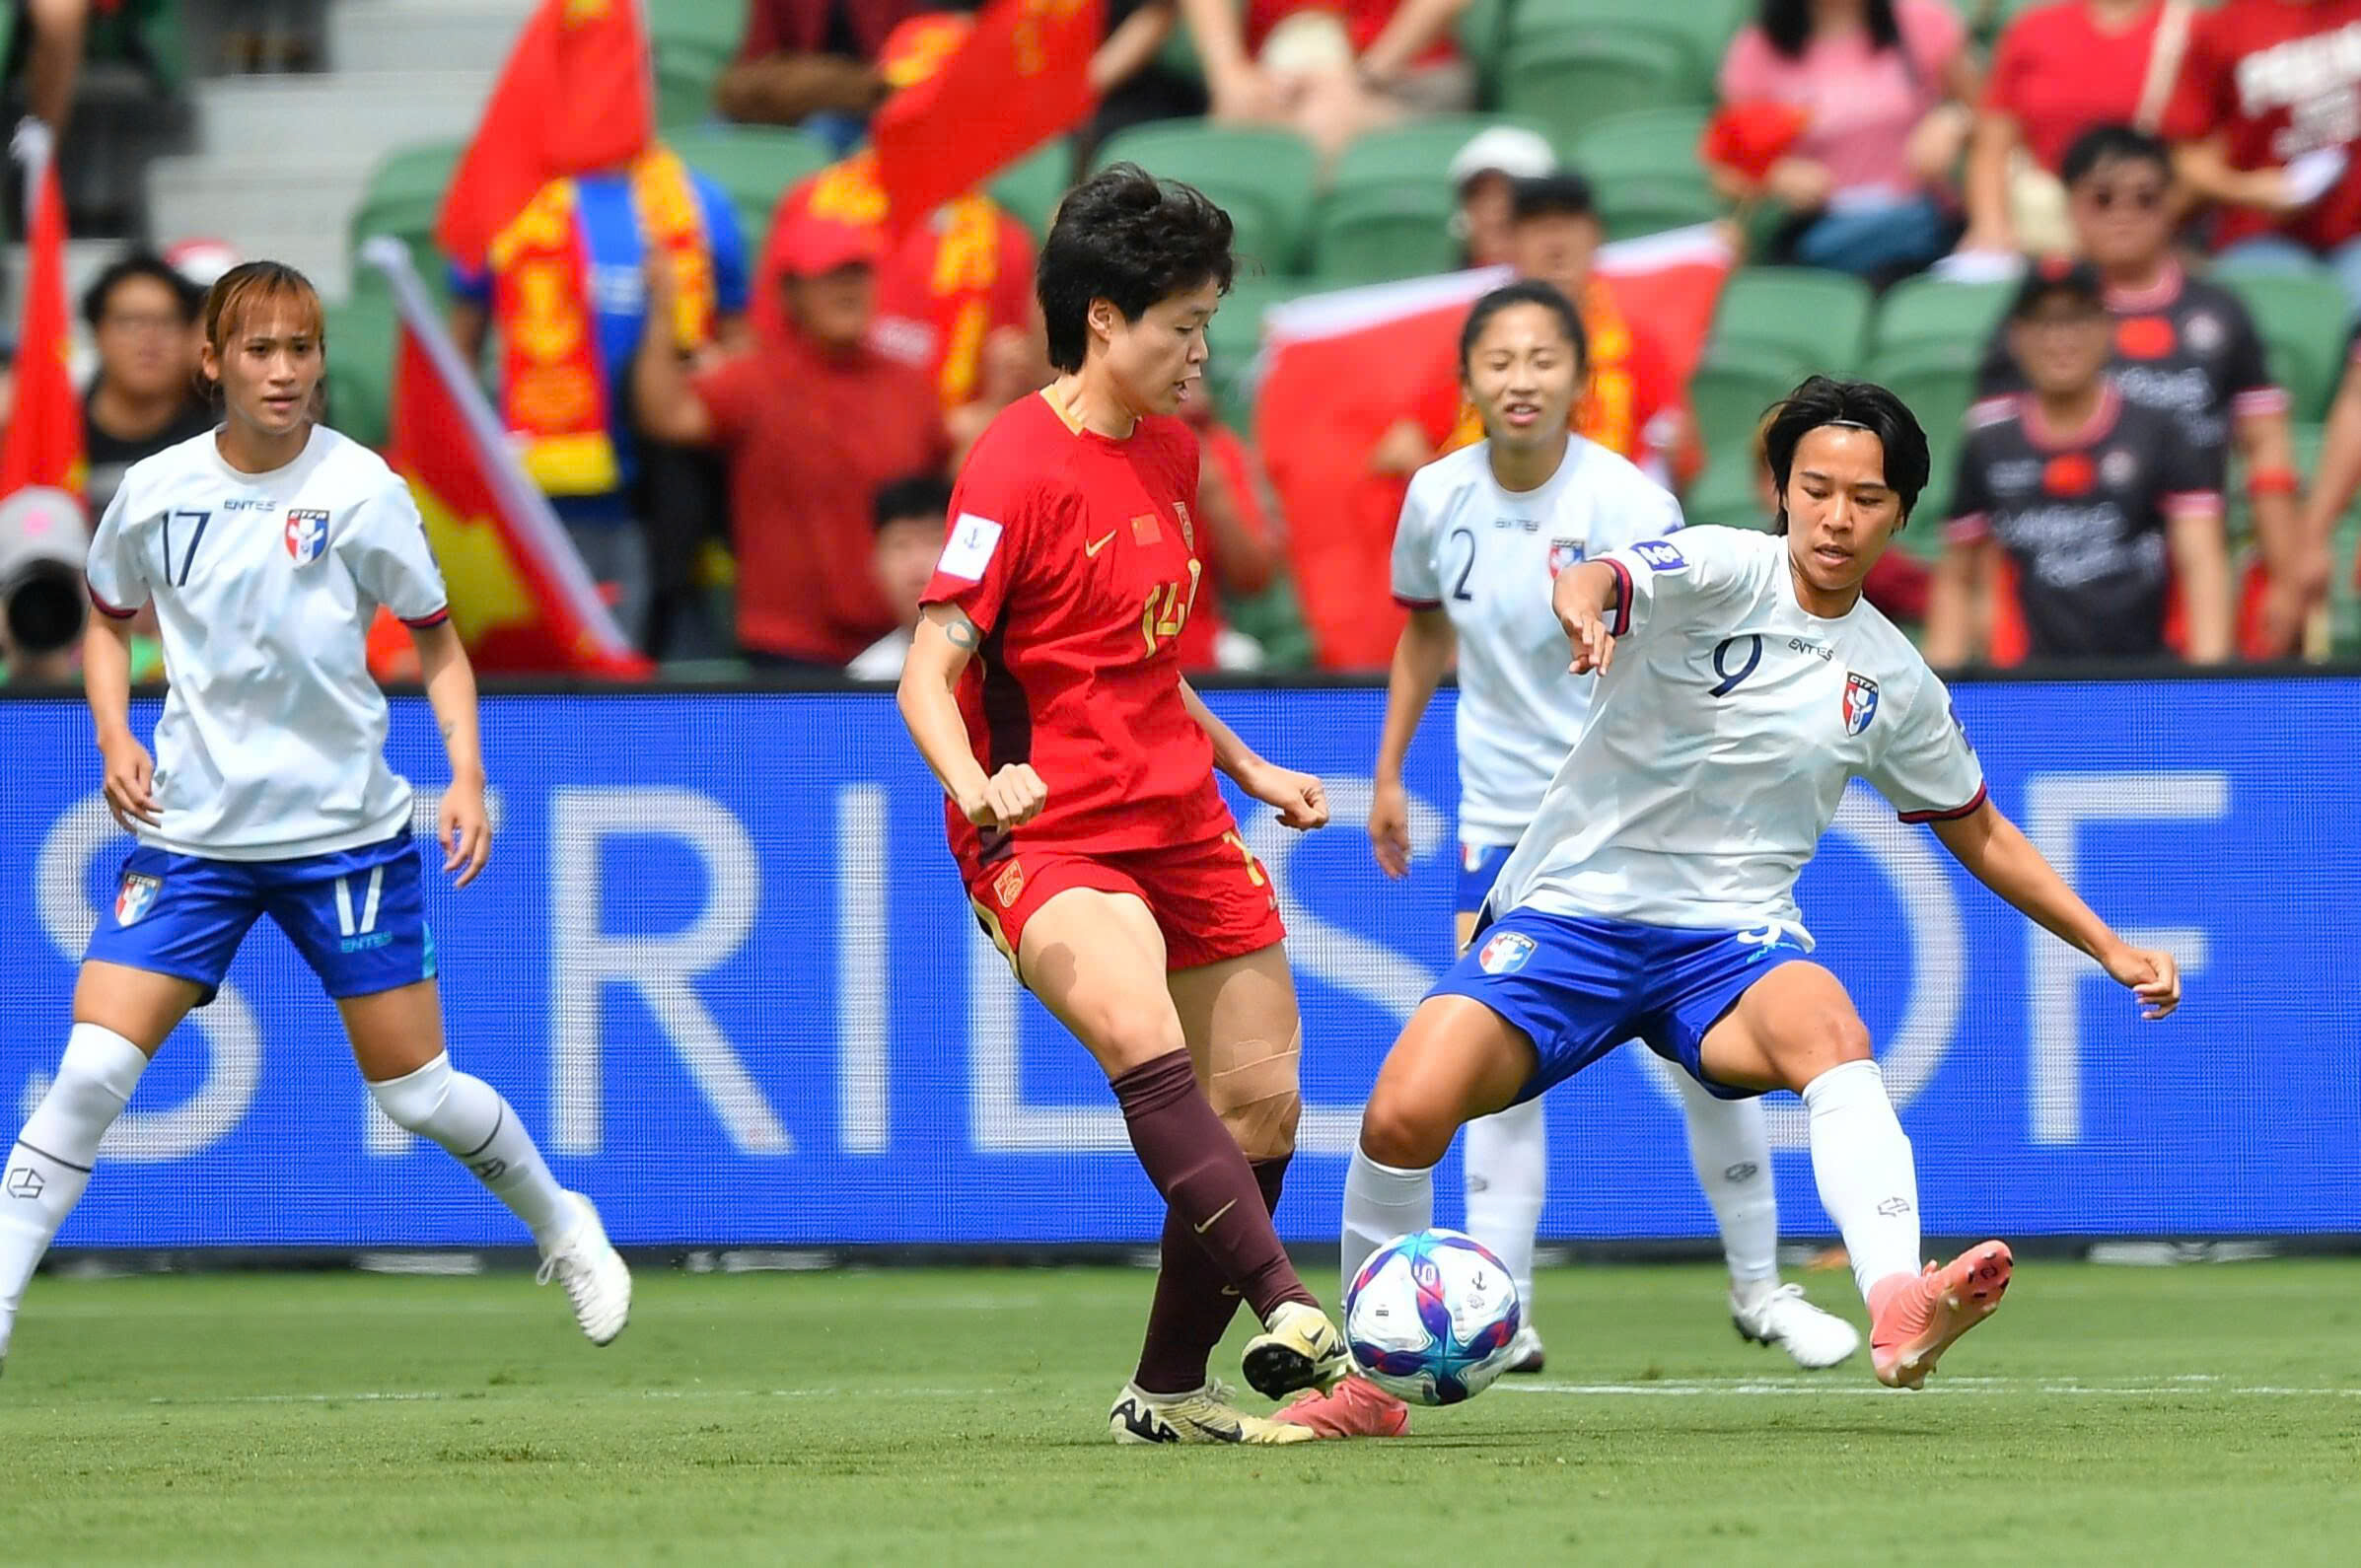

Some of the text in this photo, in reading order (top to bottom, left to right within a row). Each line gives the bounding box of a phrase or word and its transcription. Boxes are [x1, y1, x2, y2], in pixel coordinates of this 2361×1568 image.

[223, 499, 277, 512] ENTES
[162, 511, 211, 586] 17
[1451, 529, 1476, 602] 2
[1142, 558, 1202, 659] 14
[1707, 633, 1762, 698] 9
[1788, 638, 1834, 662] ENTES
